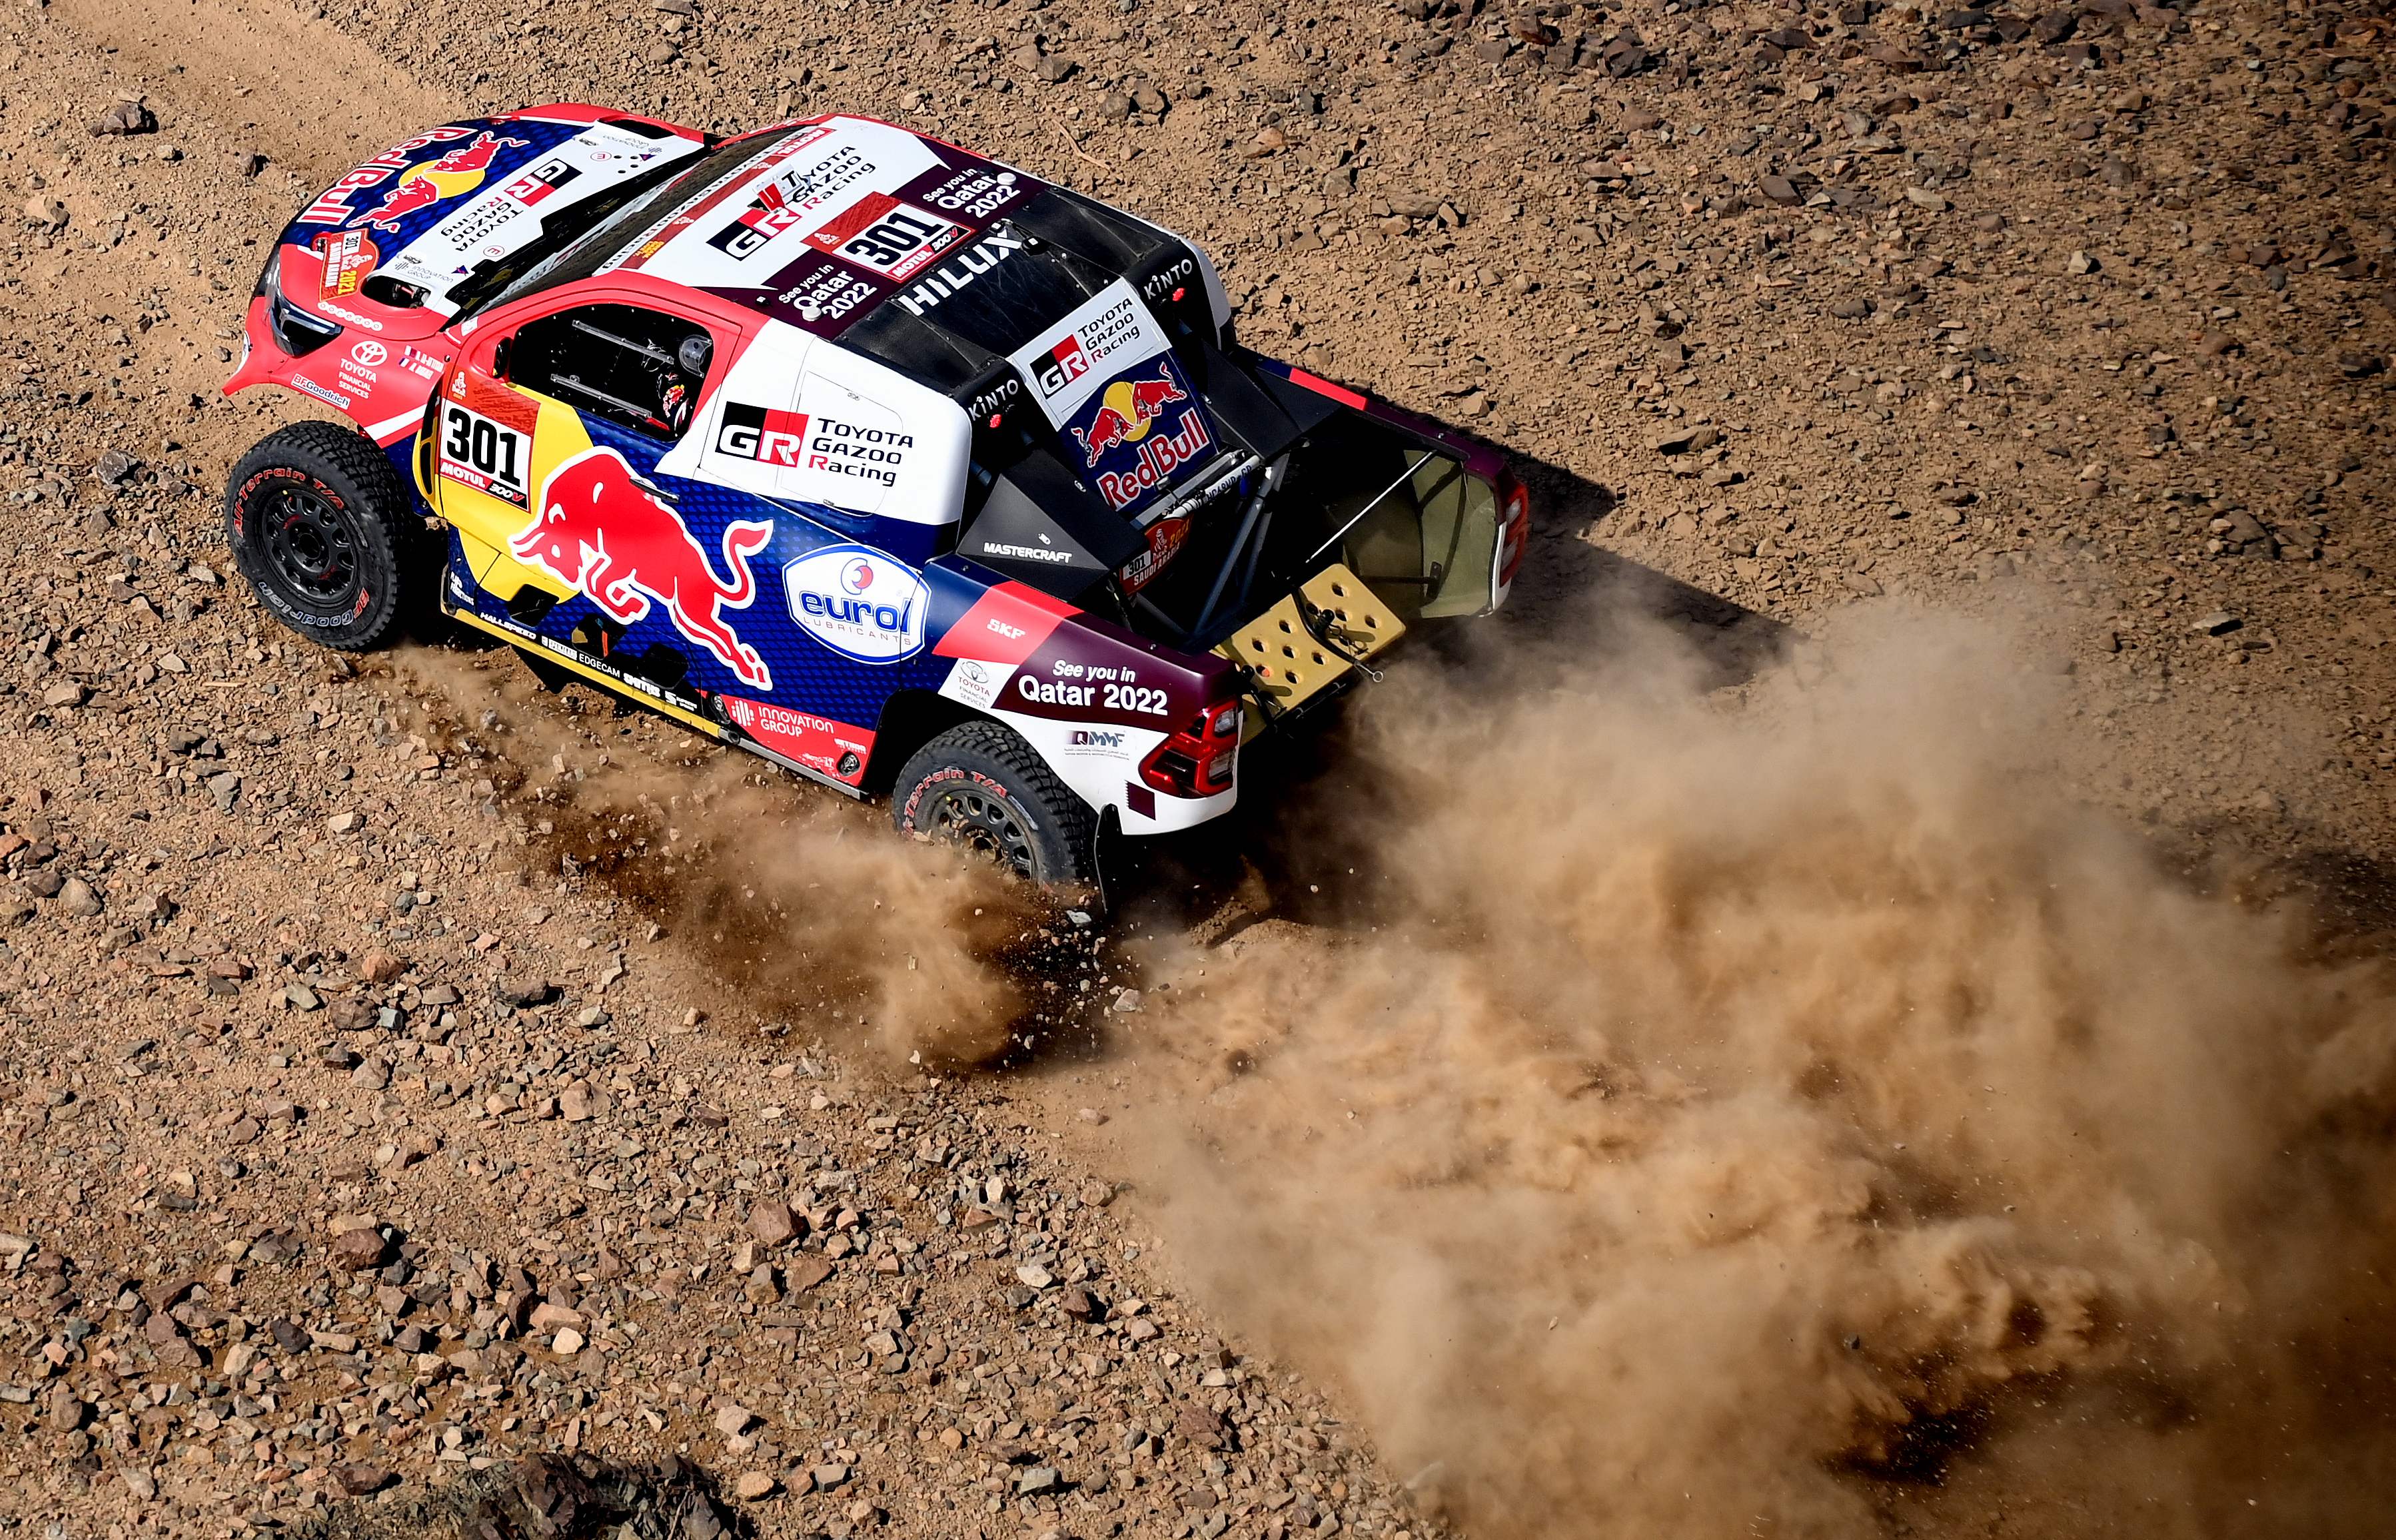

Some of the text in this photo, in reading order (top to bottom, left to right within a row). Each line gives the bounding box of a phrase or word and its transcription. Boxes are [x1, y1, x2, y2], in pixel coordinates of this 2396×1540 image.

[777, 128, 826, 155] MOTUL
[296, 126, 478, 225] Red Bull
[505, 159, 568, 199] GR
[802, 163, 876, 210] Racing
[922, 167, 977, 202] See you in
[937, 175, 998, 210] Qatar
[440, 196, 505, 237] Racing
[965, 184, 1021, 219] 2022
[451, 202, 512, 244] GAZOO
[455, 208, 524, 252] TOYOTA
[725, 206, 802, 258] GR
[844, 211, 945, 266] 301
[345, 236, 359, 250] 301
[892, 226, 959, 278] MOTUL 300V
[338, 270, 358, 294] 2021
[778, 264, 835, 304] See you in
[897, 225, 1023, 316] HILUX
[793, 270, 855, 312] Qatar
[822, 282, 878, 320] 2022
[1077, 298, 1133, 338] TOYOTA
[1085, 312, 1135, 351] GAZOO
[1091, 325, 1141, 364] Racing
[292, 374, 350, 406] BFGoodrich
[338, 371, 372, 392] FINANCIAL
[338, 380, 370, 400] SERVICES
[340, 358, 378, 384] TOYOTA
[1039, 349, 1090, 396] GR
[446, 407, 521, 488] 301
[719, 424, 802, 466] GR
[812, 437, 903, 465] GAZOO
[818, 417, 913, 448] TOYOTA
[808, 454, 897, 488] Racing
[1096, 444, 1160, 512] Red
[1147, 406, 1211, 477] Bull
[440, 461, 525, 502] MOTUL 300V
[983, 542, 1073, 564] MASTERCRAFT
[1127, 555, 1147, 576] 301
[1133, 566, 1157, 586] SAUDI
[258, 581, 370, 627] BFGoodrich
[799, 590, 913, 636] eurol
[803, 617, 911, 645] LUBRICANTS
[986, 618, 1026, 639] SKF
[578, 653, 620, 678] EDGECAM
[1052, 659, 1137, 683] See you in
[957, 675, 991, 697] TOYOTA
[1017, 674, 1169, 717] Qatar 2022
[758, 706, 835, 734] INNOVATION
[760, 721, 804, 738] GROUP
[903, 766, 965, 839] ll-Terrain
